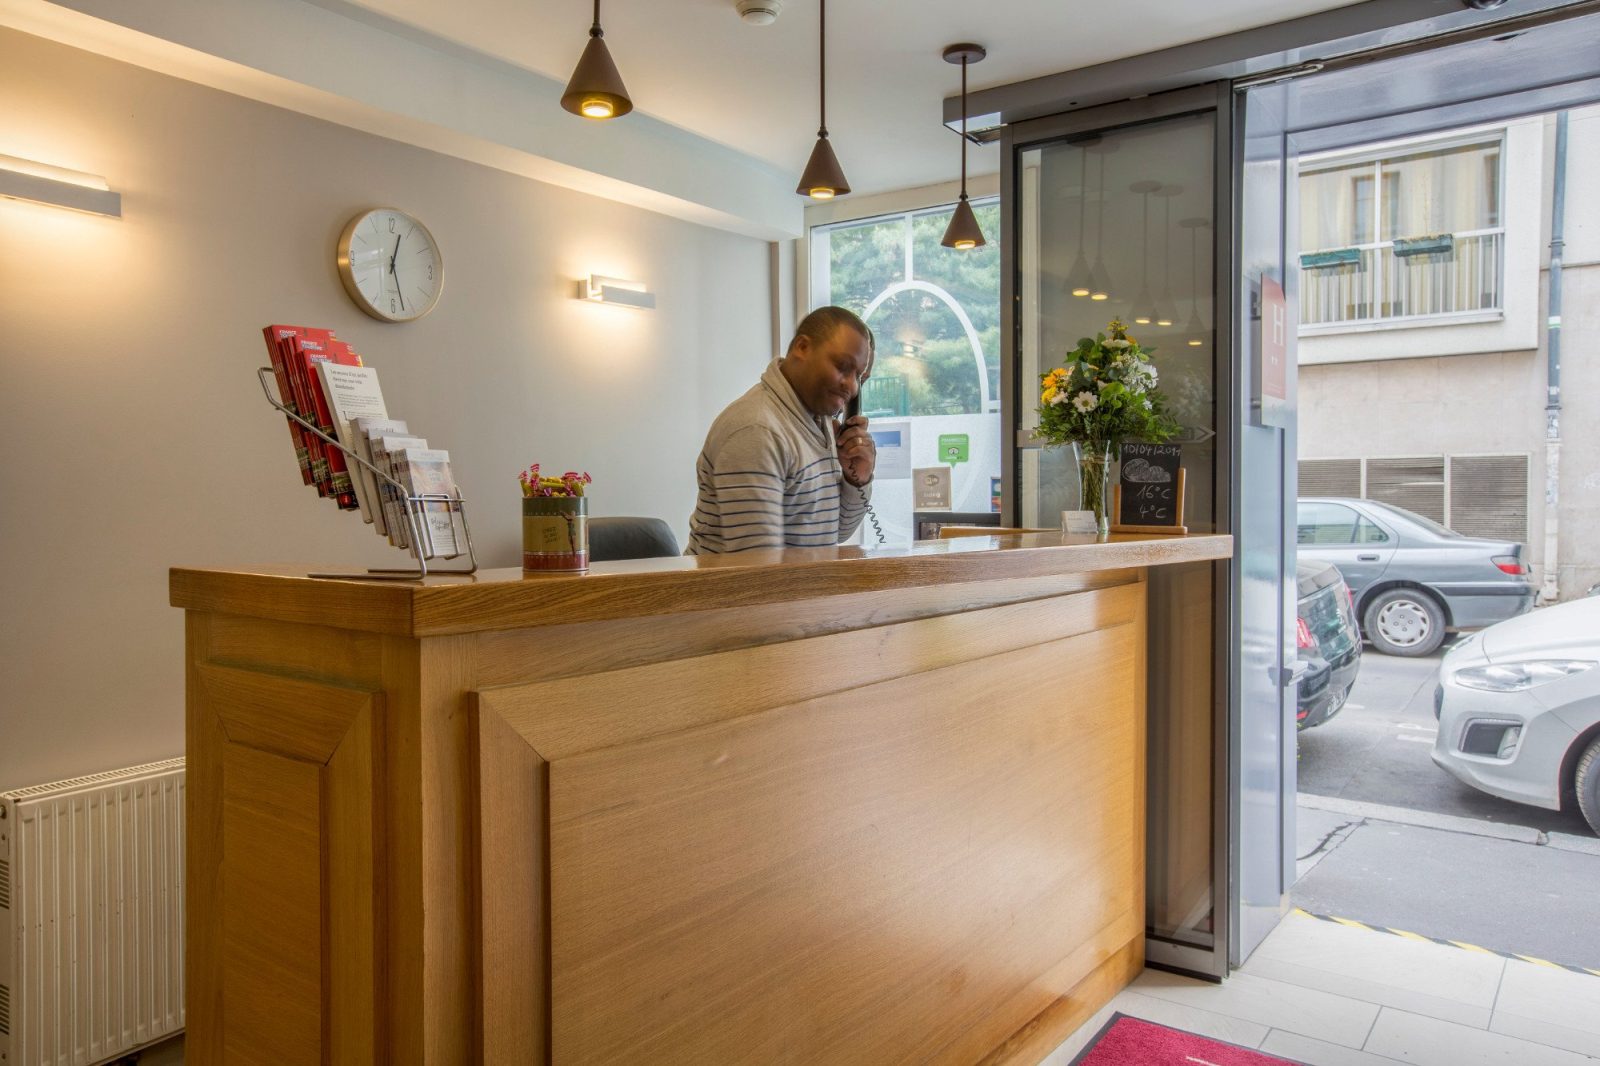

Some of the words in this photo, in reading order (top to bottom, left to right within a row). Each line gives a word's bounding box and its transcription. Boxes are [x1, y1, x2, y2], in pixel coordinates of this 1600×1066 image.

[388, 217, 396, 234] 12
[427, 264, 433, 281] 3
[390, 298, 396, 314] 6
[1273, 303, 1285, 347] H
